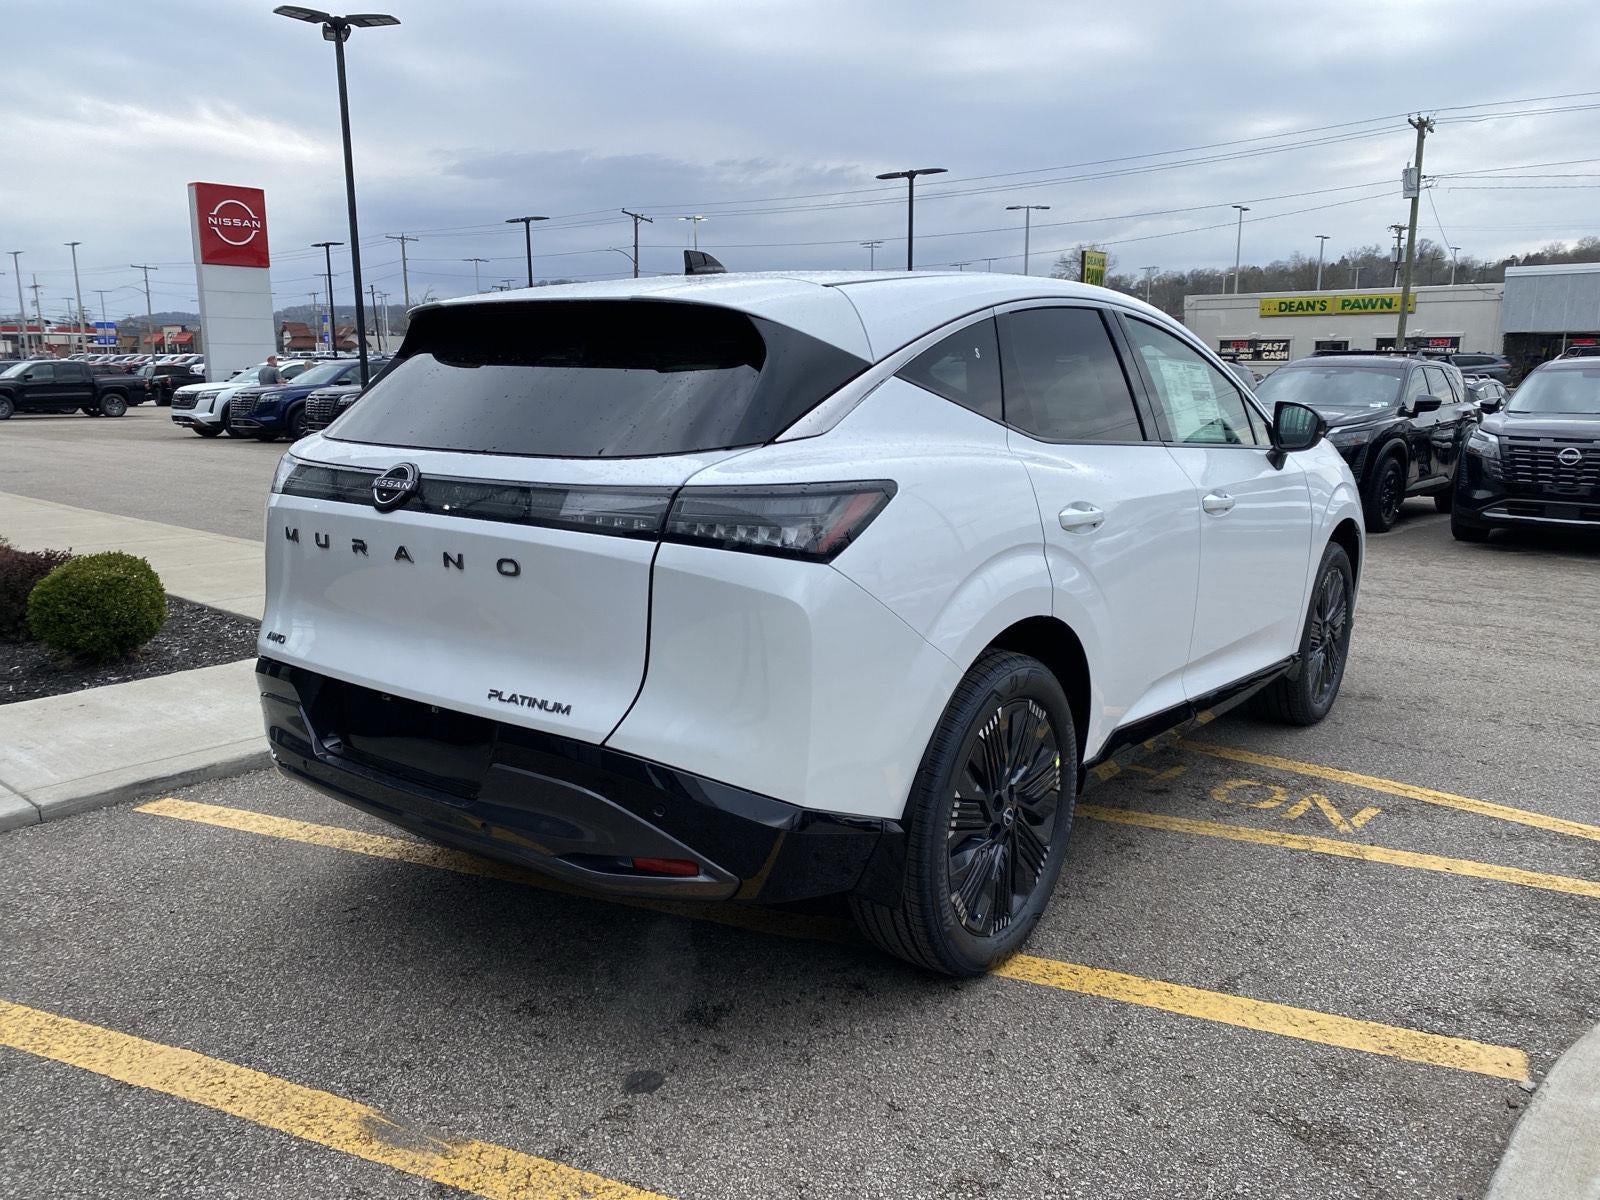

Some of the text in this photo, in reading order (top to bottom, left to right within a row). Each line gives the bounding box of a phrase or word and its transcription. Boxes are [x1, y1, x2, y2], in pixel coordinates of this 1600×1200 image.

[208, 216, 261, 229] NISSAN
[1278, 297, 1393, 313] DEAN'S PAWN
[1259, 342, 1286, 351] FAST
[1262, 351, 1288, 360] CASH
[372, 479, 411, 491] NISSAN
[285, 526, 521, 577] MURANO
[267, 631, 286, 645] AWD
[488, 688, 571, 716] PLATINUM
